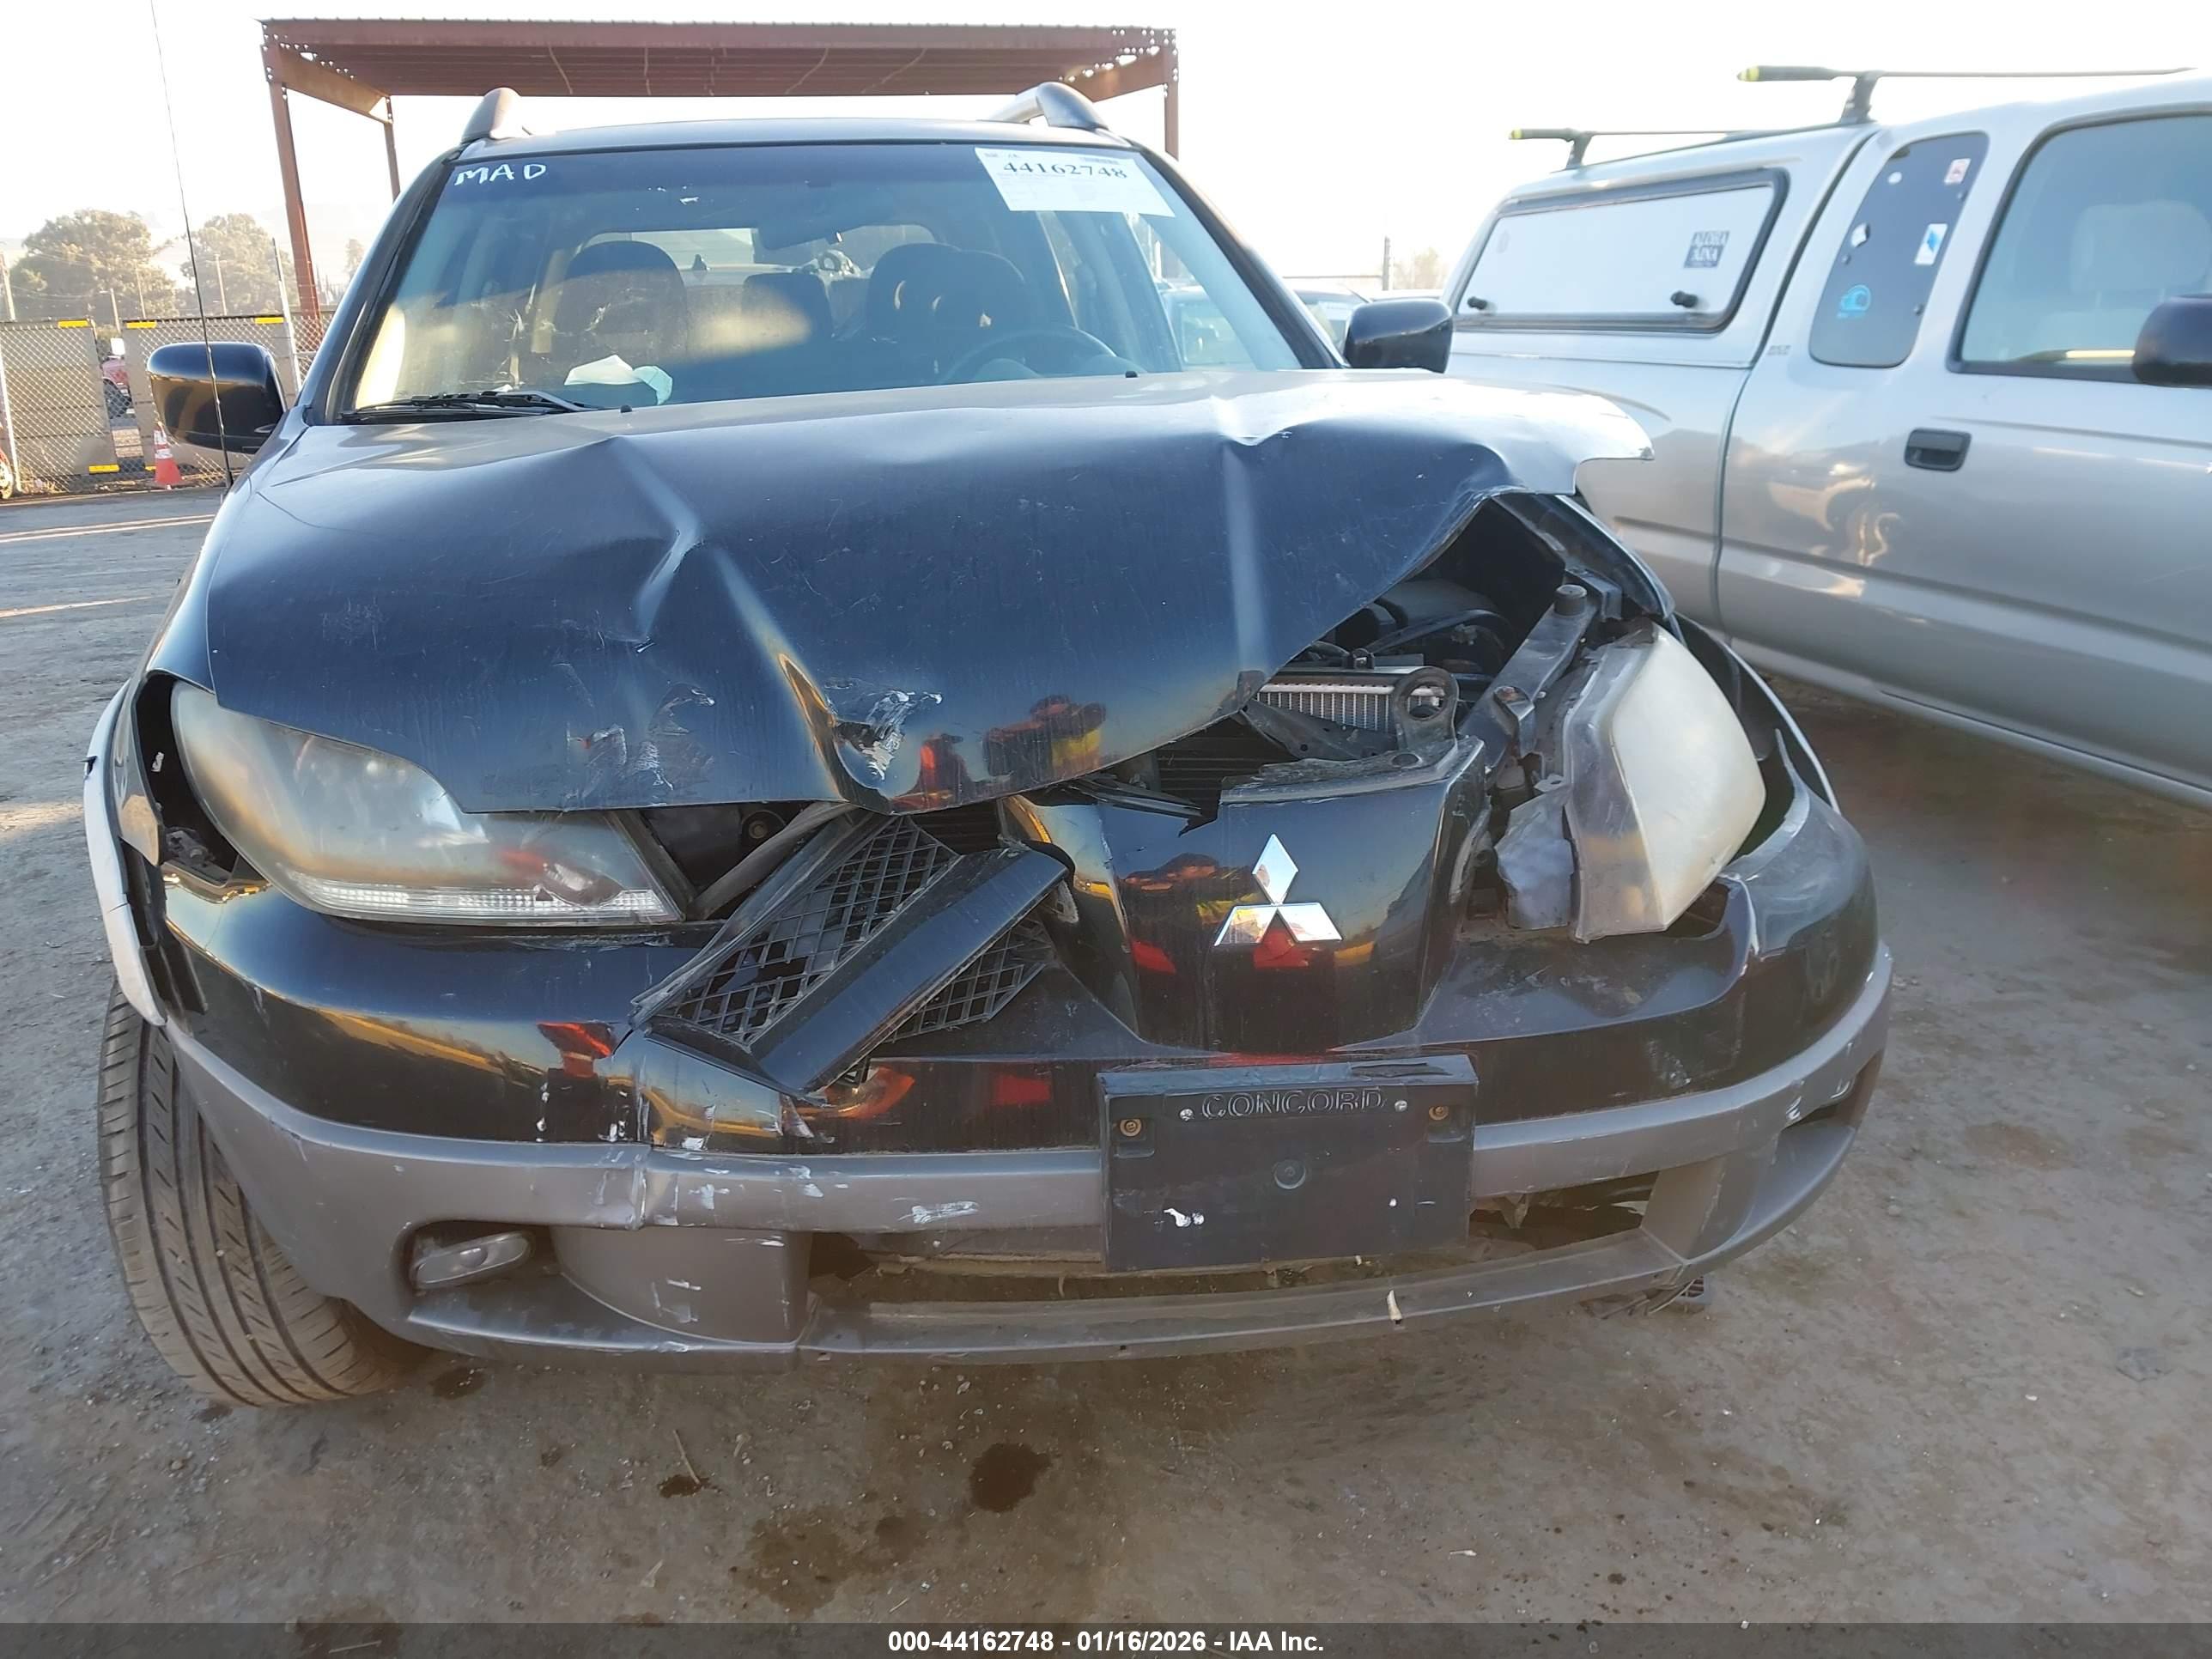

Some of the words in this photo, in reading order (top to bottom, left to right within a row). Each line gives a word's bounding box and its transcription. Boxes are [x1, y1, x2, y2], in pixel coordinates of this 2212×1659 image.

[454, 163, 546, 185] MAD
[1003, 161, 1128, 179] 44162748
[1201, 1086, 1385, 1119] CONCORD
